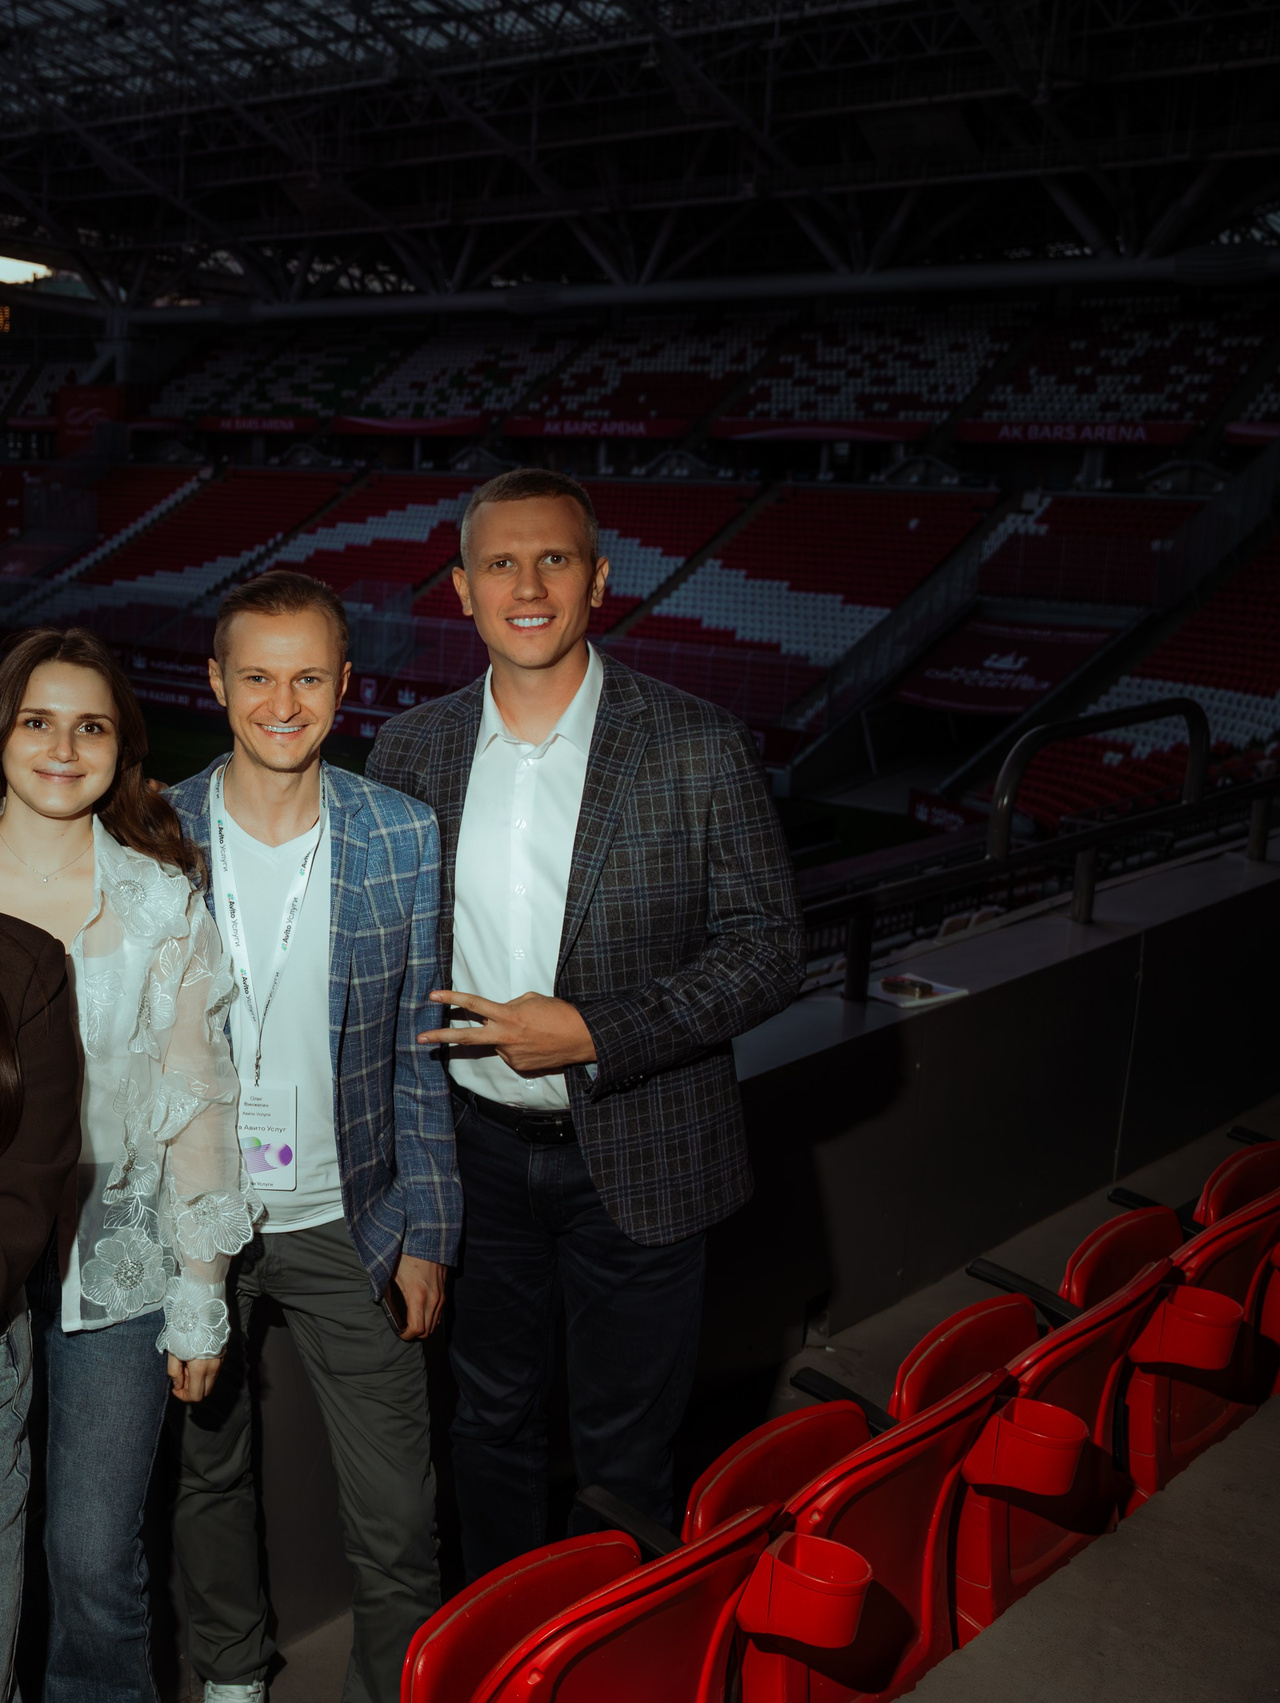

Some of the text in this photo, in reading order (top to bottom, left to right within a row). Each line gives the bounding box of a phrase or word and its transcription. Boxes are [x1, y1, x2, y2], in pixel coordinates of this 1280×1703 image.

[998, 424, 1147, 441] AK BARS ARENA
[220, 844, 228, 872] Услуги
[231, 919, 240, 947] Услуги
[282, 896, 298, 943] Avito Услуги
[244, 1124, 266, 1132] Авито
[266, 1125, 287, 1133] Услуг
